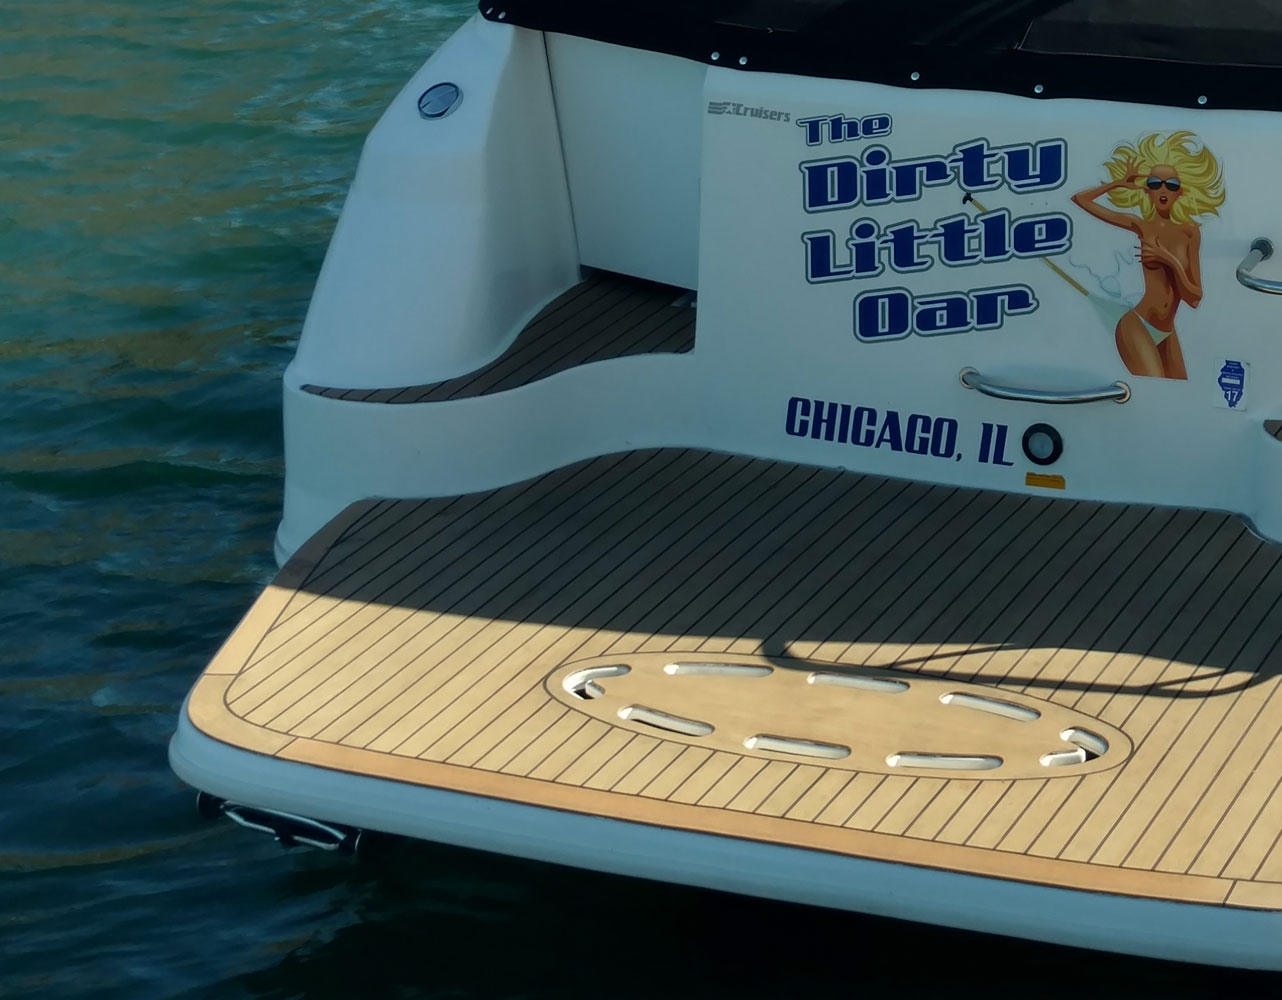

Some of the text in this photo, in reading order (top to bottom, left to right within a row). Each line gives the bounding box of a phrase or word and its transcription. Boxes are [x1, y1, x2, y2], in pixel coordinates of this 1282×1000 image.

[735, 102, 791, 123] Cruisers
[797, 114, 891, 145] The
[802, 140, 1065, 211] Dirty
[803, 210, 1070, 282] Little
[855, 286, 1036, 341] Oar
[1226, 391, 1239, 402] 17
[785, 396, 1014, 466] CHICAGO, IL
